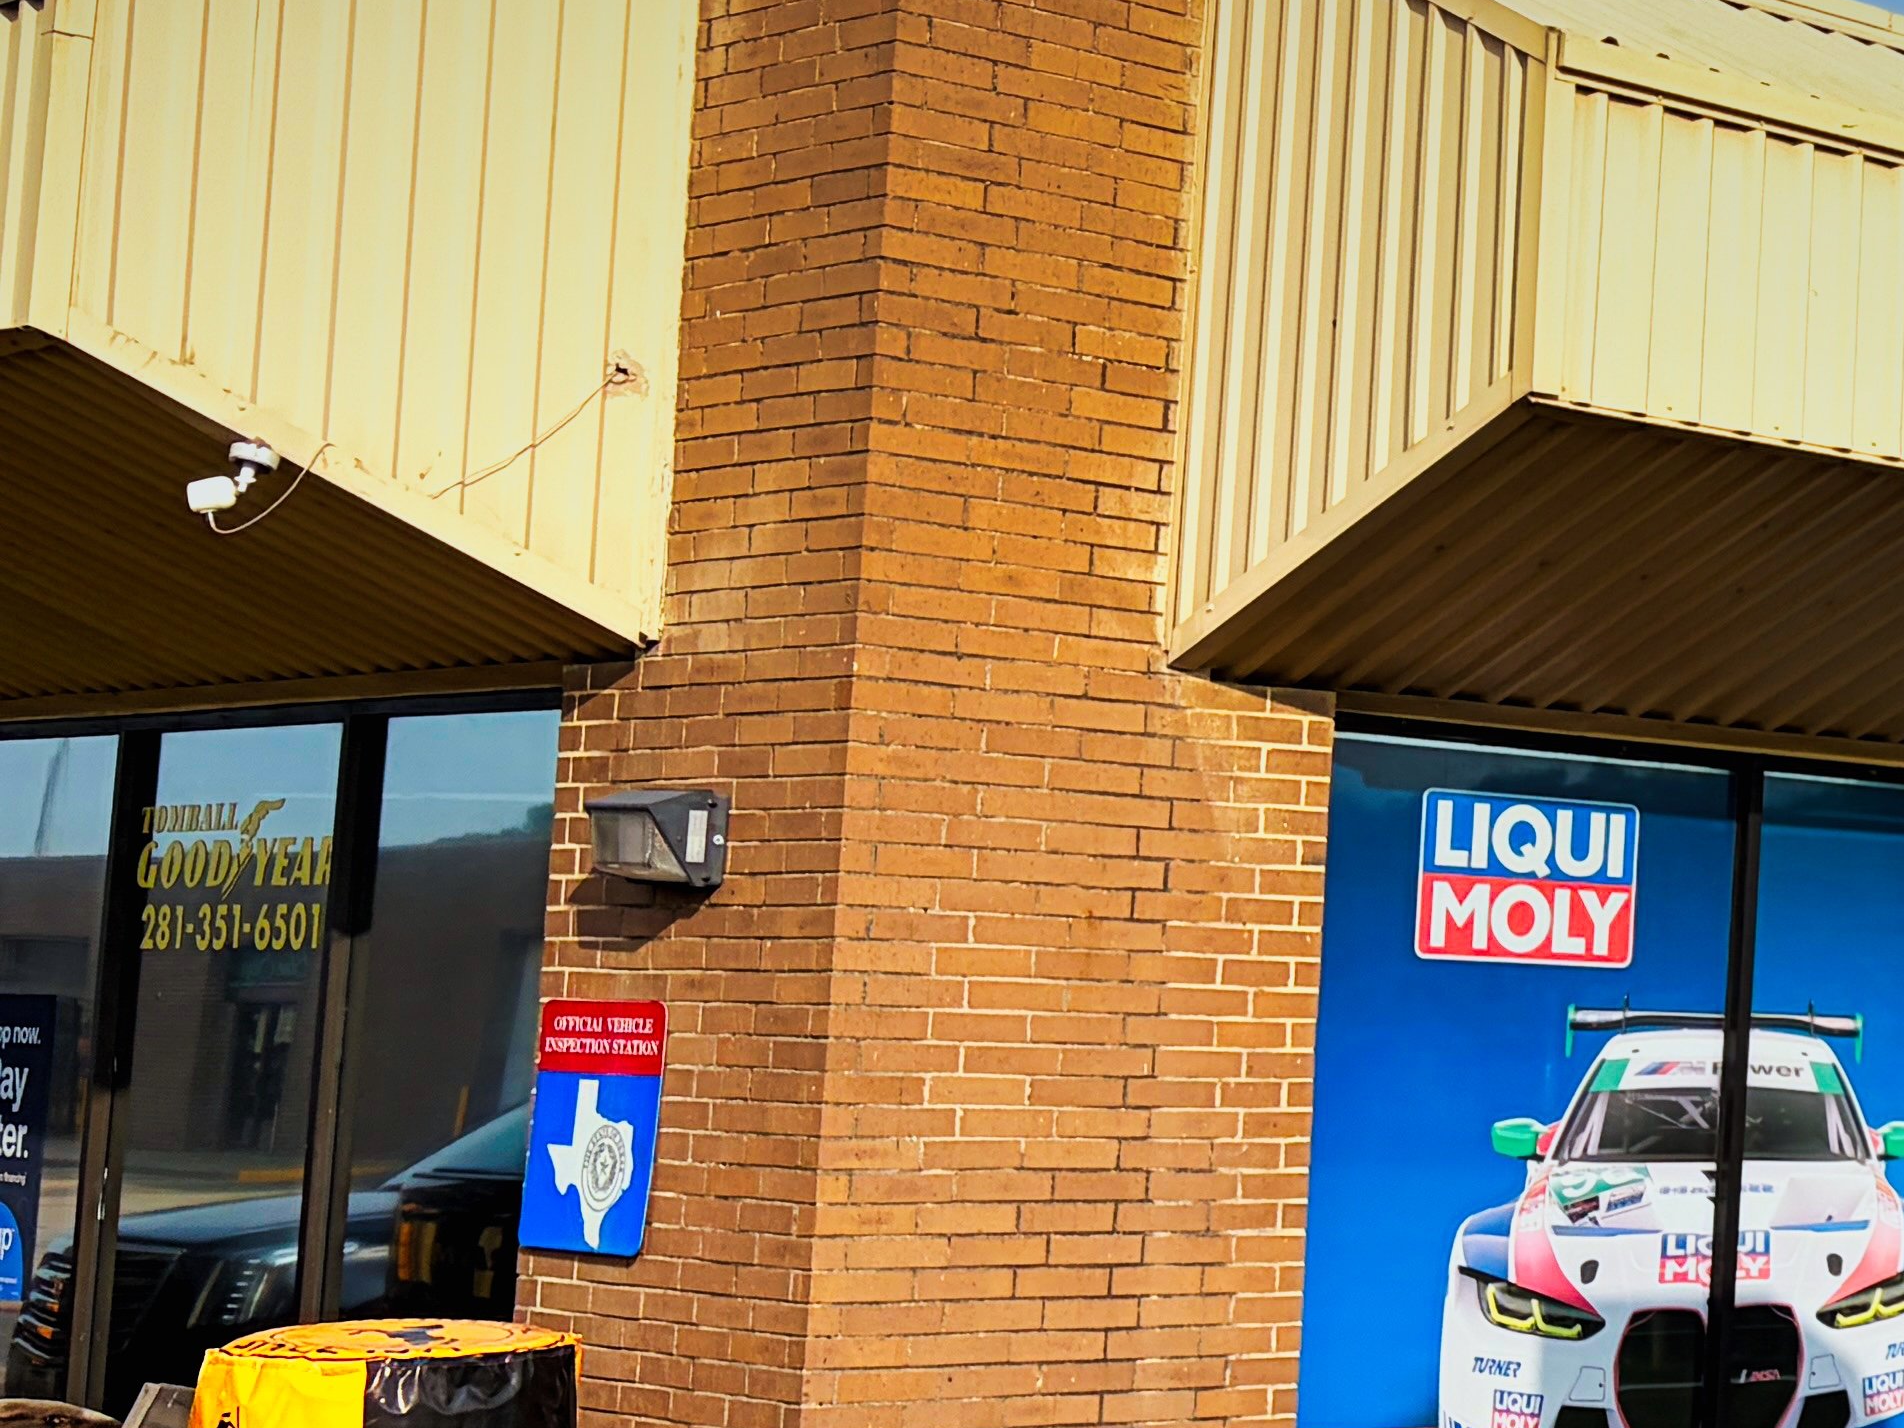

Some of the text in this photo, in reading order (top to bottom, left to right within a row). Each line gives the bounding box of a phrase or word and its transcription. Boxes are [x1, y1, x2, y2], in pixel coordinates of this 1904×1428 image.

[142, 802, 239, 833] TOMBALL
[1434, 799, 1626, 878] LIQUI
[139, 903, 320, 951] 281-351-6501
[1429, 880, 1629, 956] MOLY
[13, 1026, 41, 1045] now.
[607, 1018, 653, 1034] VEHICLE
[545, 1037, 659, 1056] INSPECTION STATION
[1472, 1356, 1521, 1378] TURNER
[1864, 1372, 1904, 1394] LIQUI
[1494, 1391, 1541, 1416] LIQUI
[1865, 1390, 1904, 1415] MOLY
